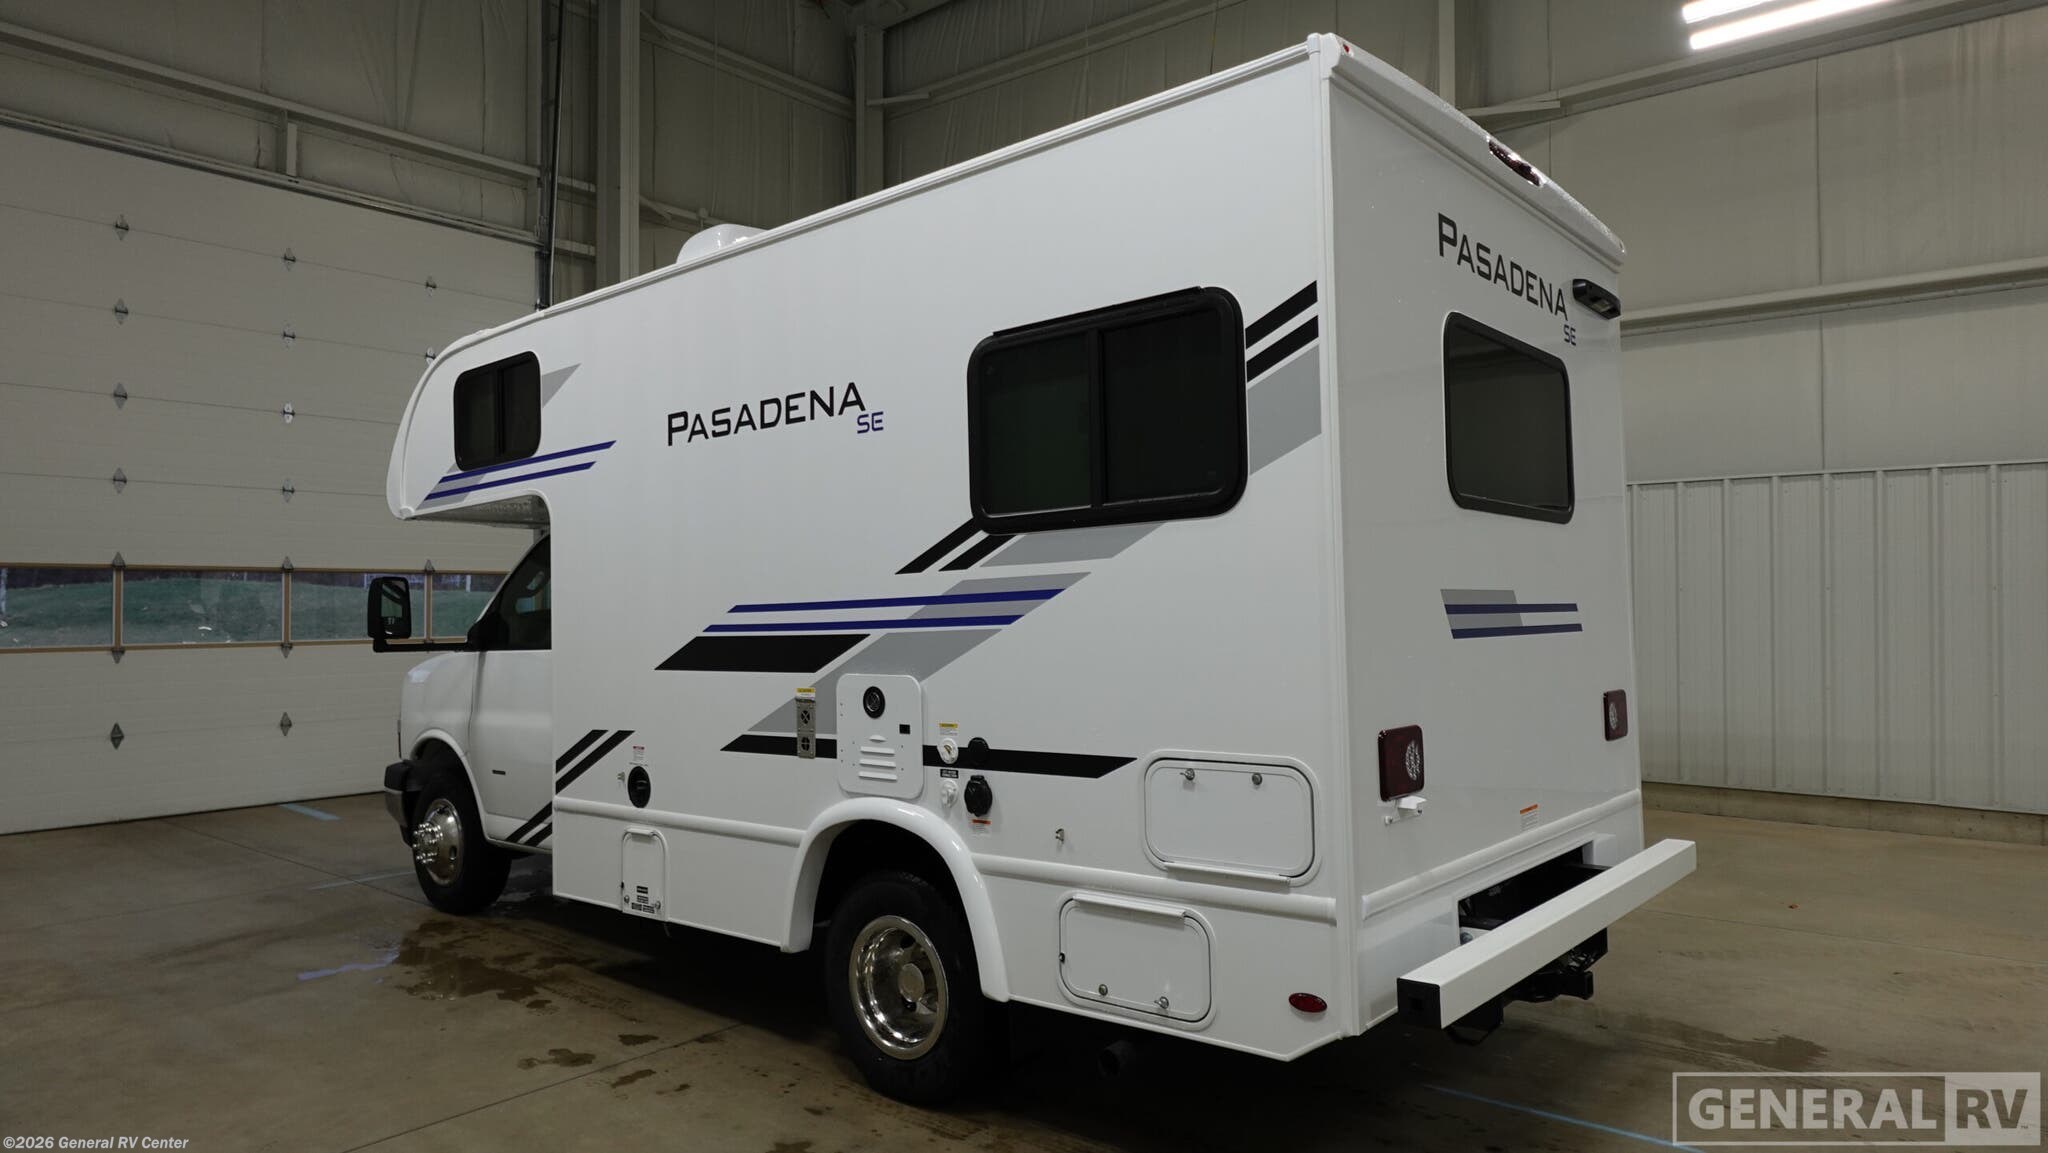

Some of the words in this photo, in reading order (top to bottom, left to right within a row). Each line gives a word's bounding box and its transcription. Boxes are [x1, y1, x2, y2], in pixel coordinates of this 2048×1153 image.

[1438, 212, 1568, 321] PASADENA
[1563, 324, 1577, 346] SE
[667, 382, 866, 446] PASADENA
[857, 411, 884, 434] SE
